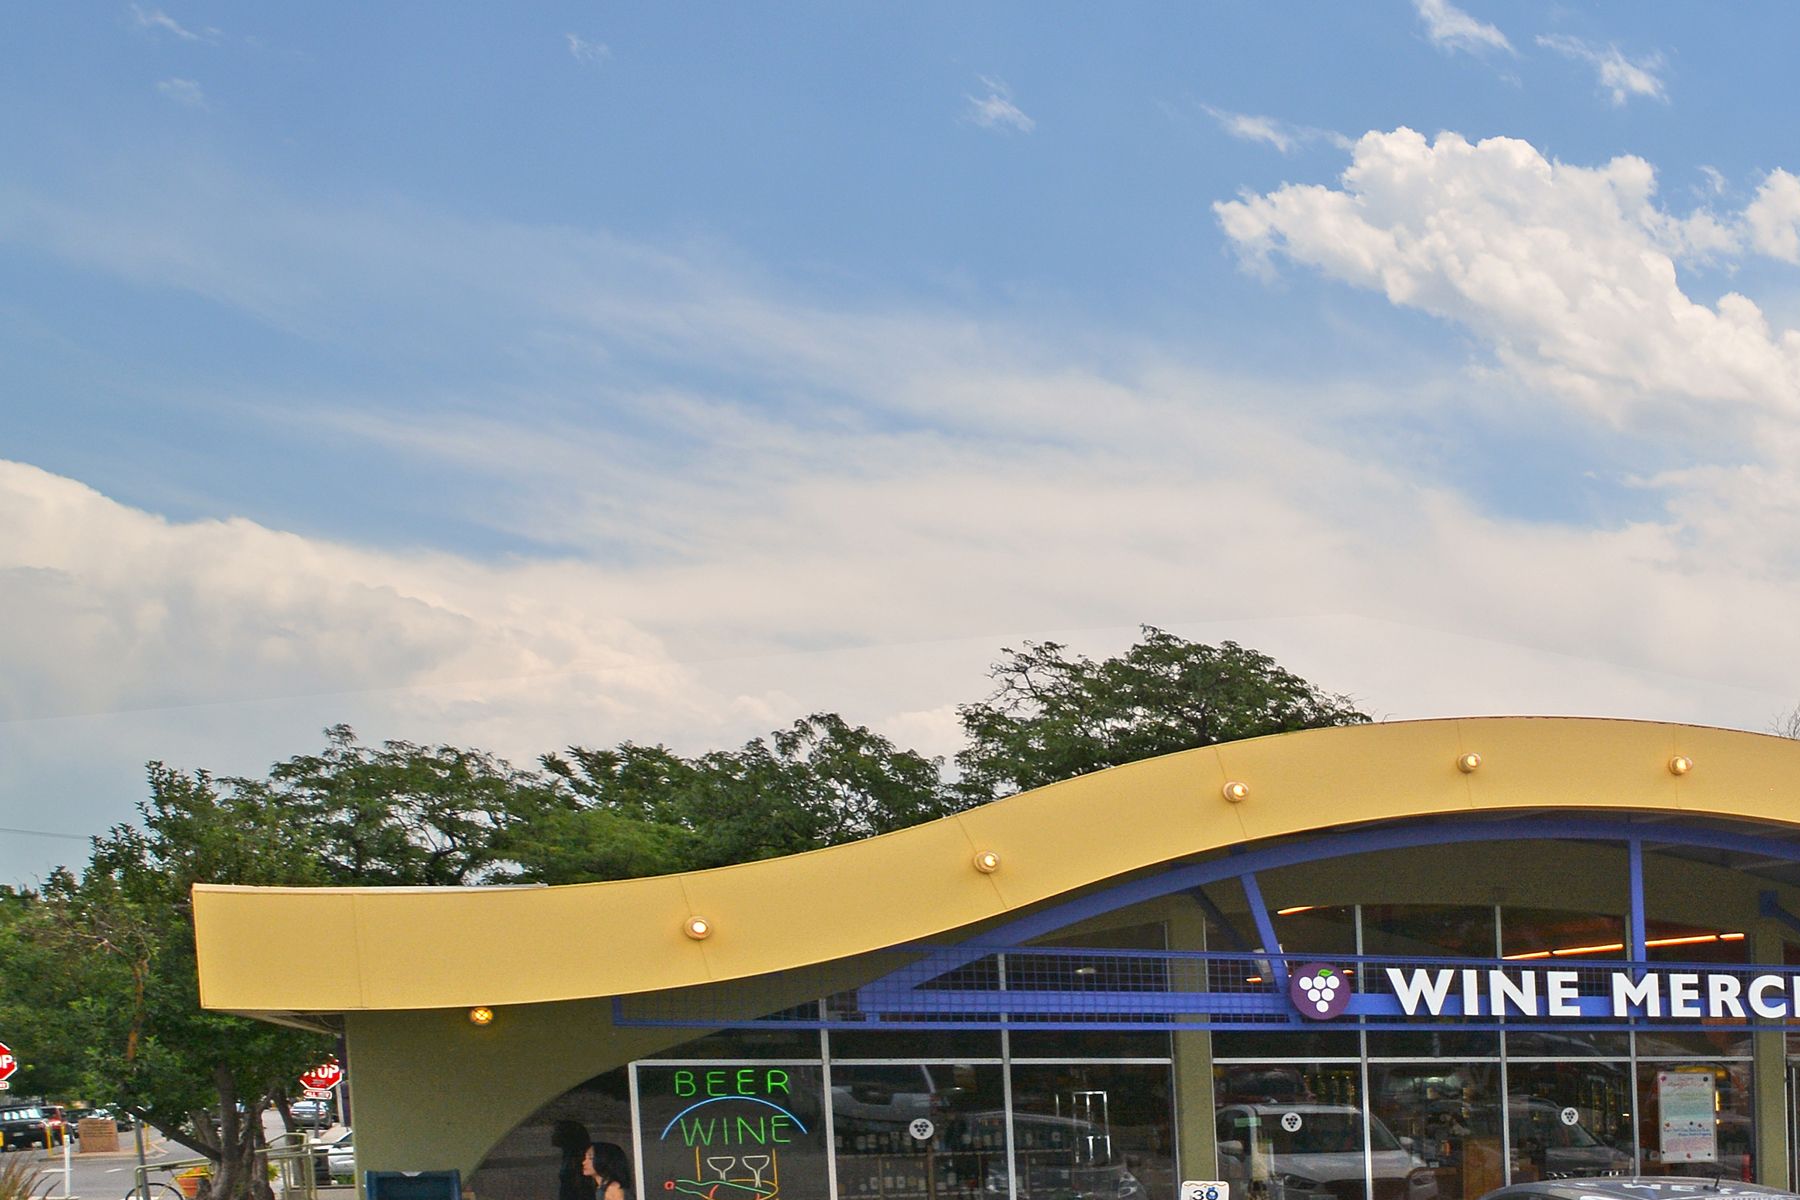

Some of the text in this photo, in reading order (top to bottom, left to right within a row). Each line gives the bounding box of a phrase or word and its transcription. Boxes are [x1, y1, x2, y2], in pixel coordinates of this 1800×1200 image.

[1385, 967, 1582, 1017] WINE
[674, 1069, 790, 1097] BEER
[680, 1115, 792, 1147] WINE
